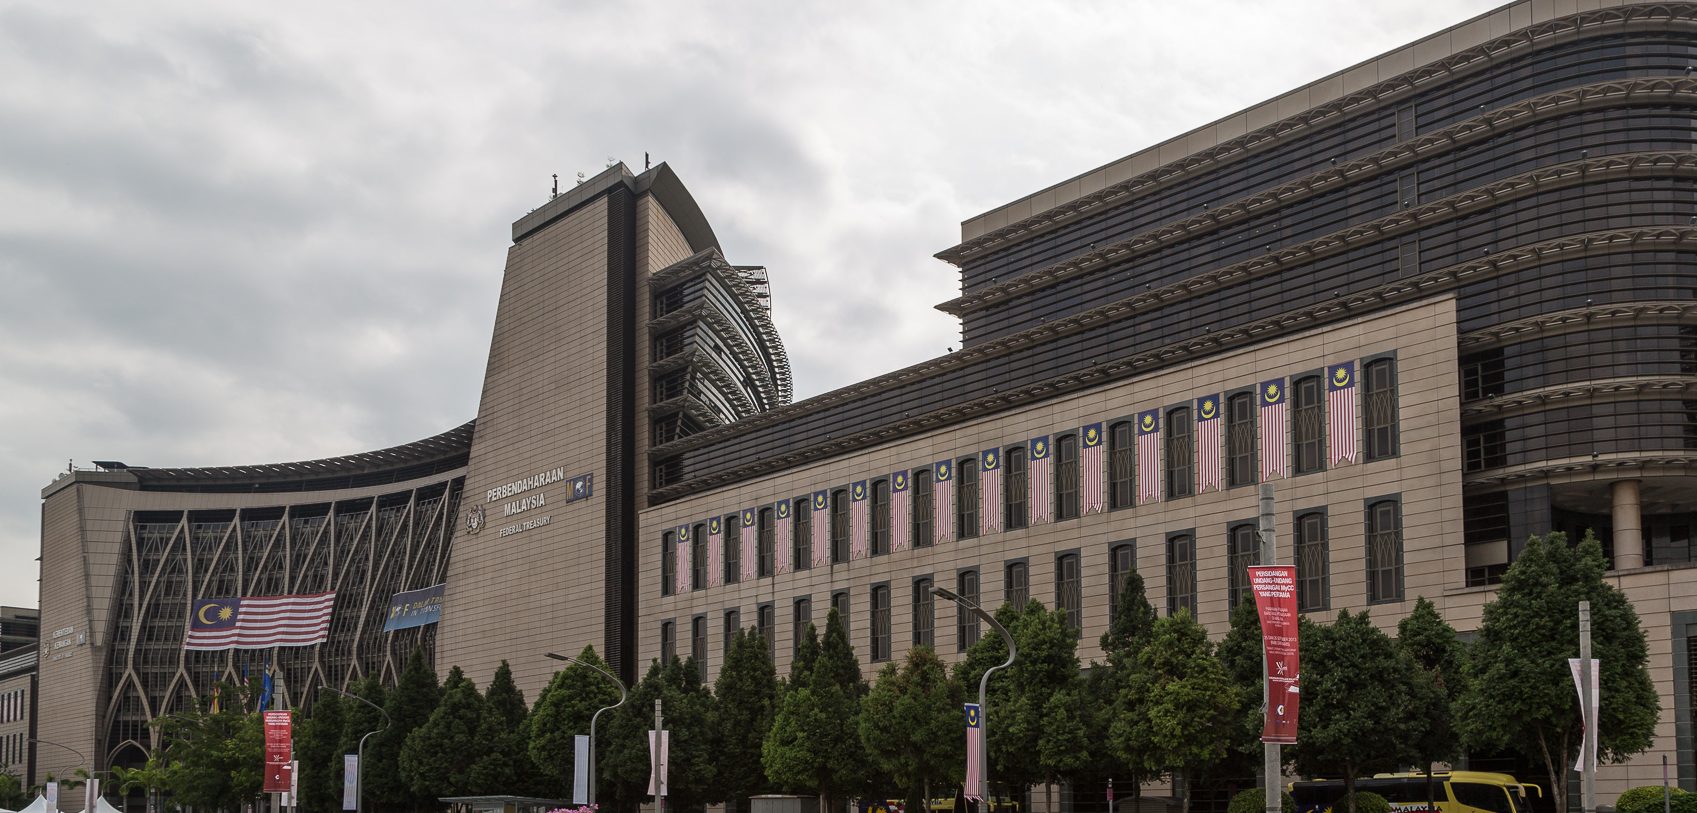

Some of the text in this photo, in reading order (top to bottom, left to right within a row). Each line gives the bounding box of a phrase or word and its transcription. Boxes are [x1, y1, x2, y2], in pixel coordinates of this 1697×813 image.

[487, 466, 564, 503] PERBENDAHARAAN
[504, 493, 545, 517] MALAYSIA
[499, 515, 552, 538] FEDERAL TREASURY
